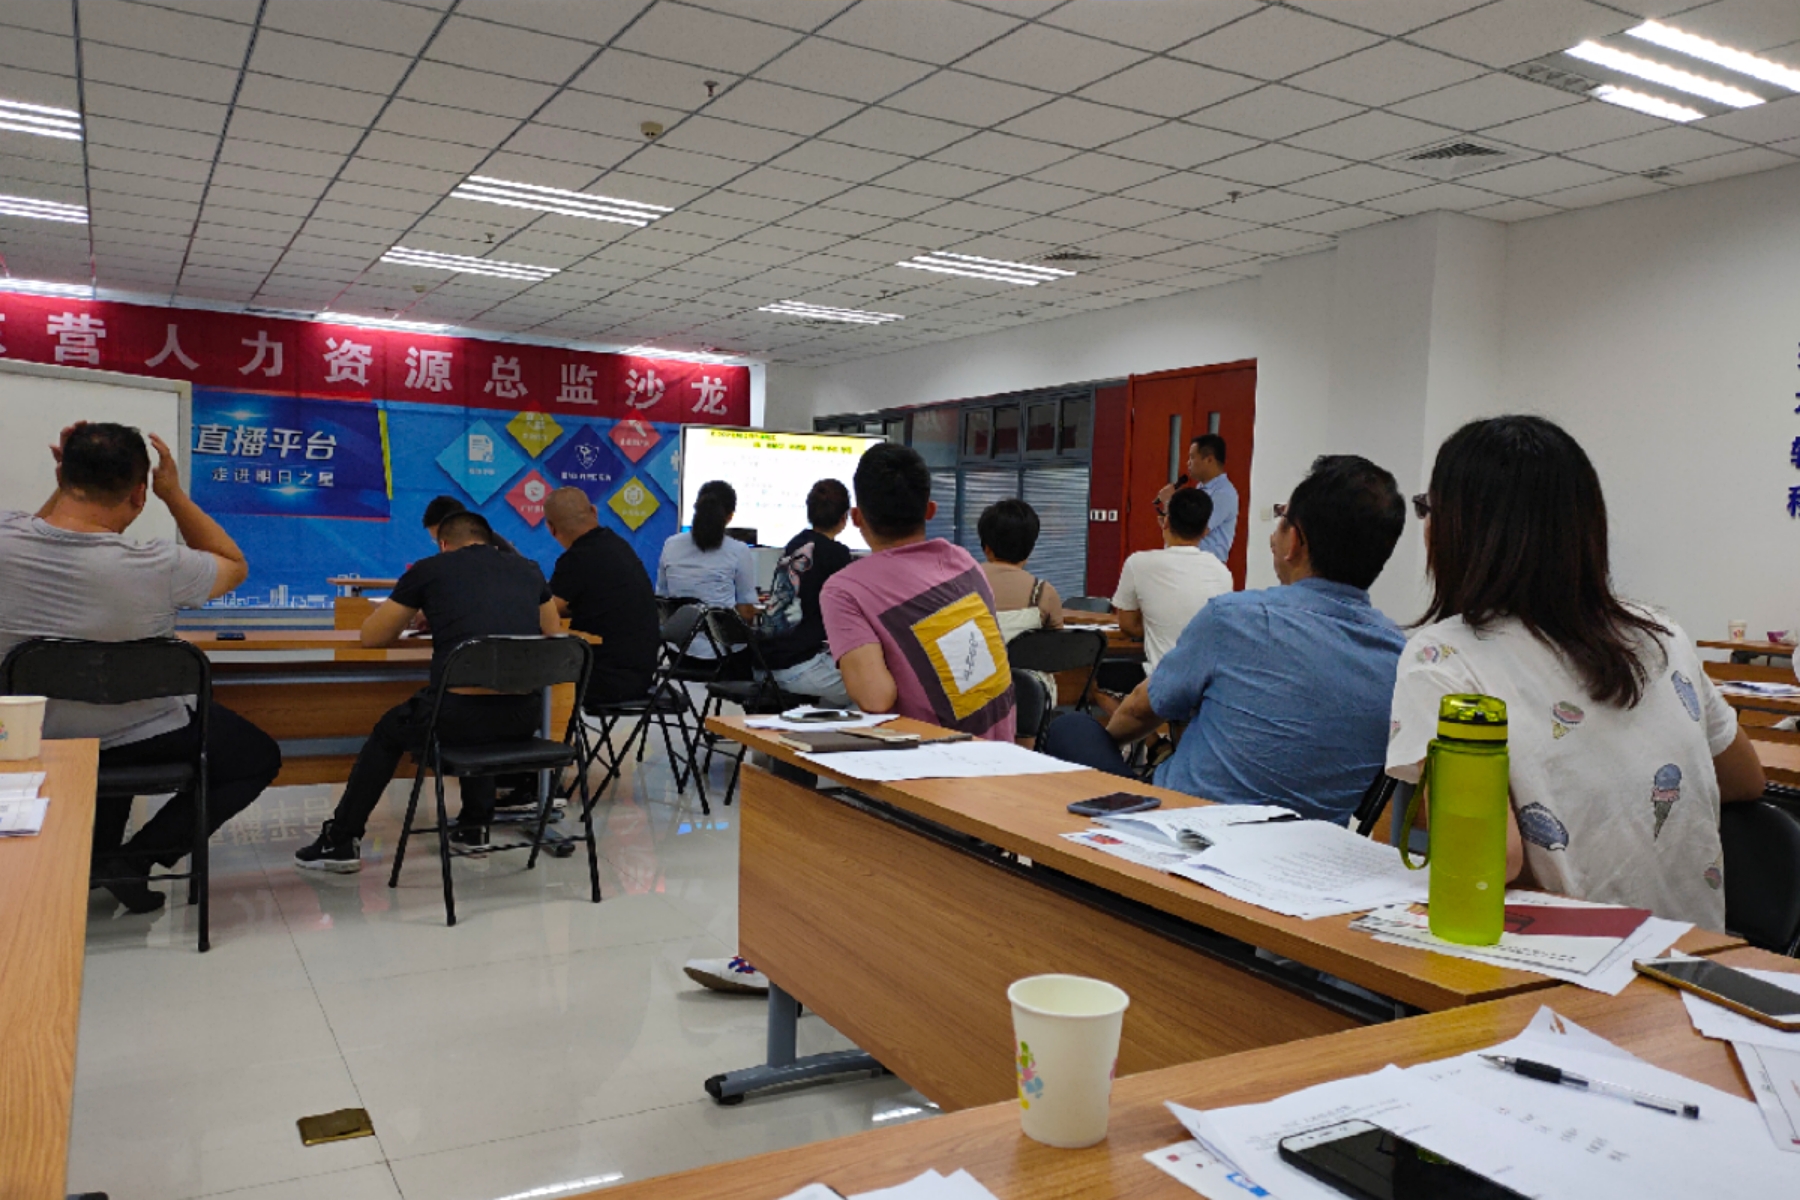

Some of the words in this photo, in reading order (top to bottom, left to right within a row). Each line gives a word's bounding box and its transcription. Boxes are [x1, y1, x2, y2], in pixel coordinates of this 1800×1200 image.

[0, 311, 728, 416] 营人力资源总监沙龙
[191, 422, 338, 461] 直播平台
[211, 465, 335, 488] 走进明日之星
